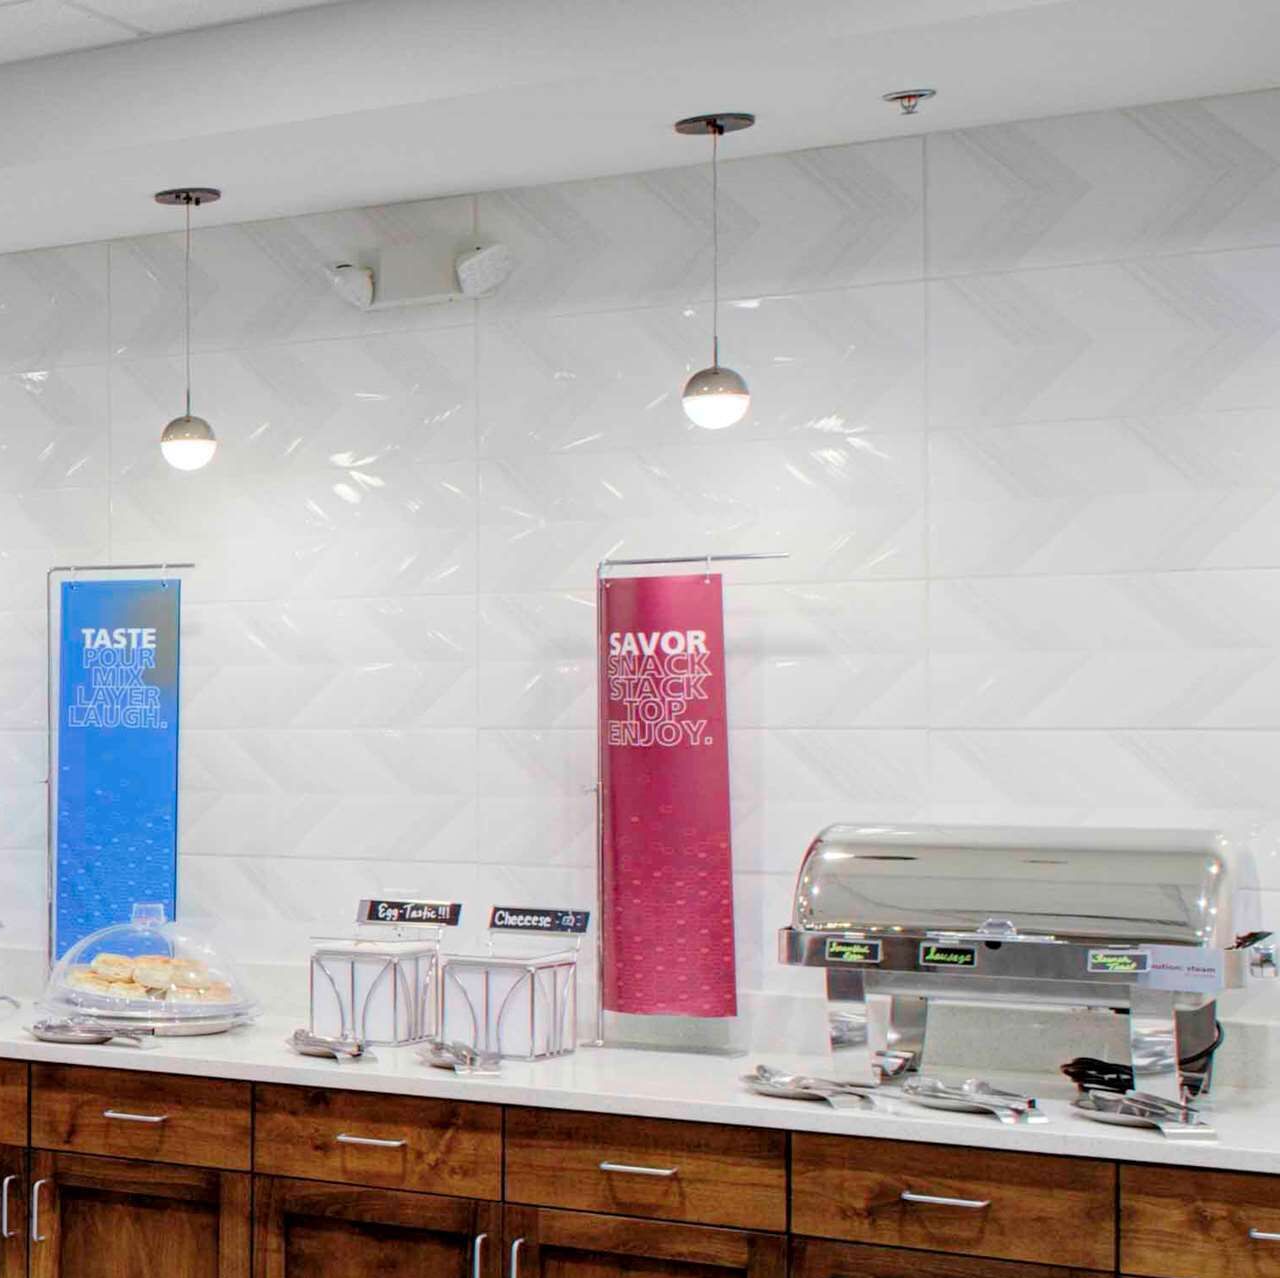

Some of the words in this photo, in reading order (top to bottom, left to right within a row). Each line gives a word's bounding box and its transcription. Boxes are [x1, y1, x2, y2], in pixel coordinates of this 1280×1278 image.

[81, 628, 157, 649] TASTE
[608, 630, 706, 655] SAVOR
[82, 648, 157, 669] POUR
[608, 650, 713, 678] SNACK
[92, 666, 145, 688] MIX
[609, 673, 709, 701] STACK
[76, 685, 161, 708] LAYER
[67, 705, 169, 729] LAUGH.
[623, 698, 687, 723] TOP
[607, 719, 714, 747] ENJOY.
